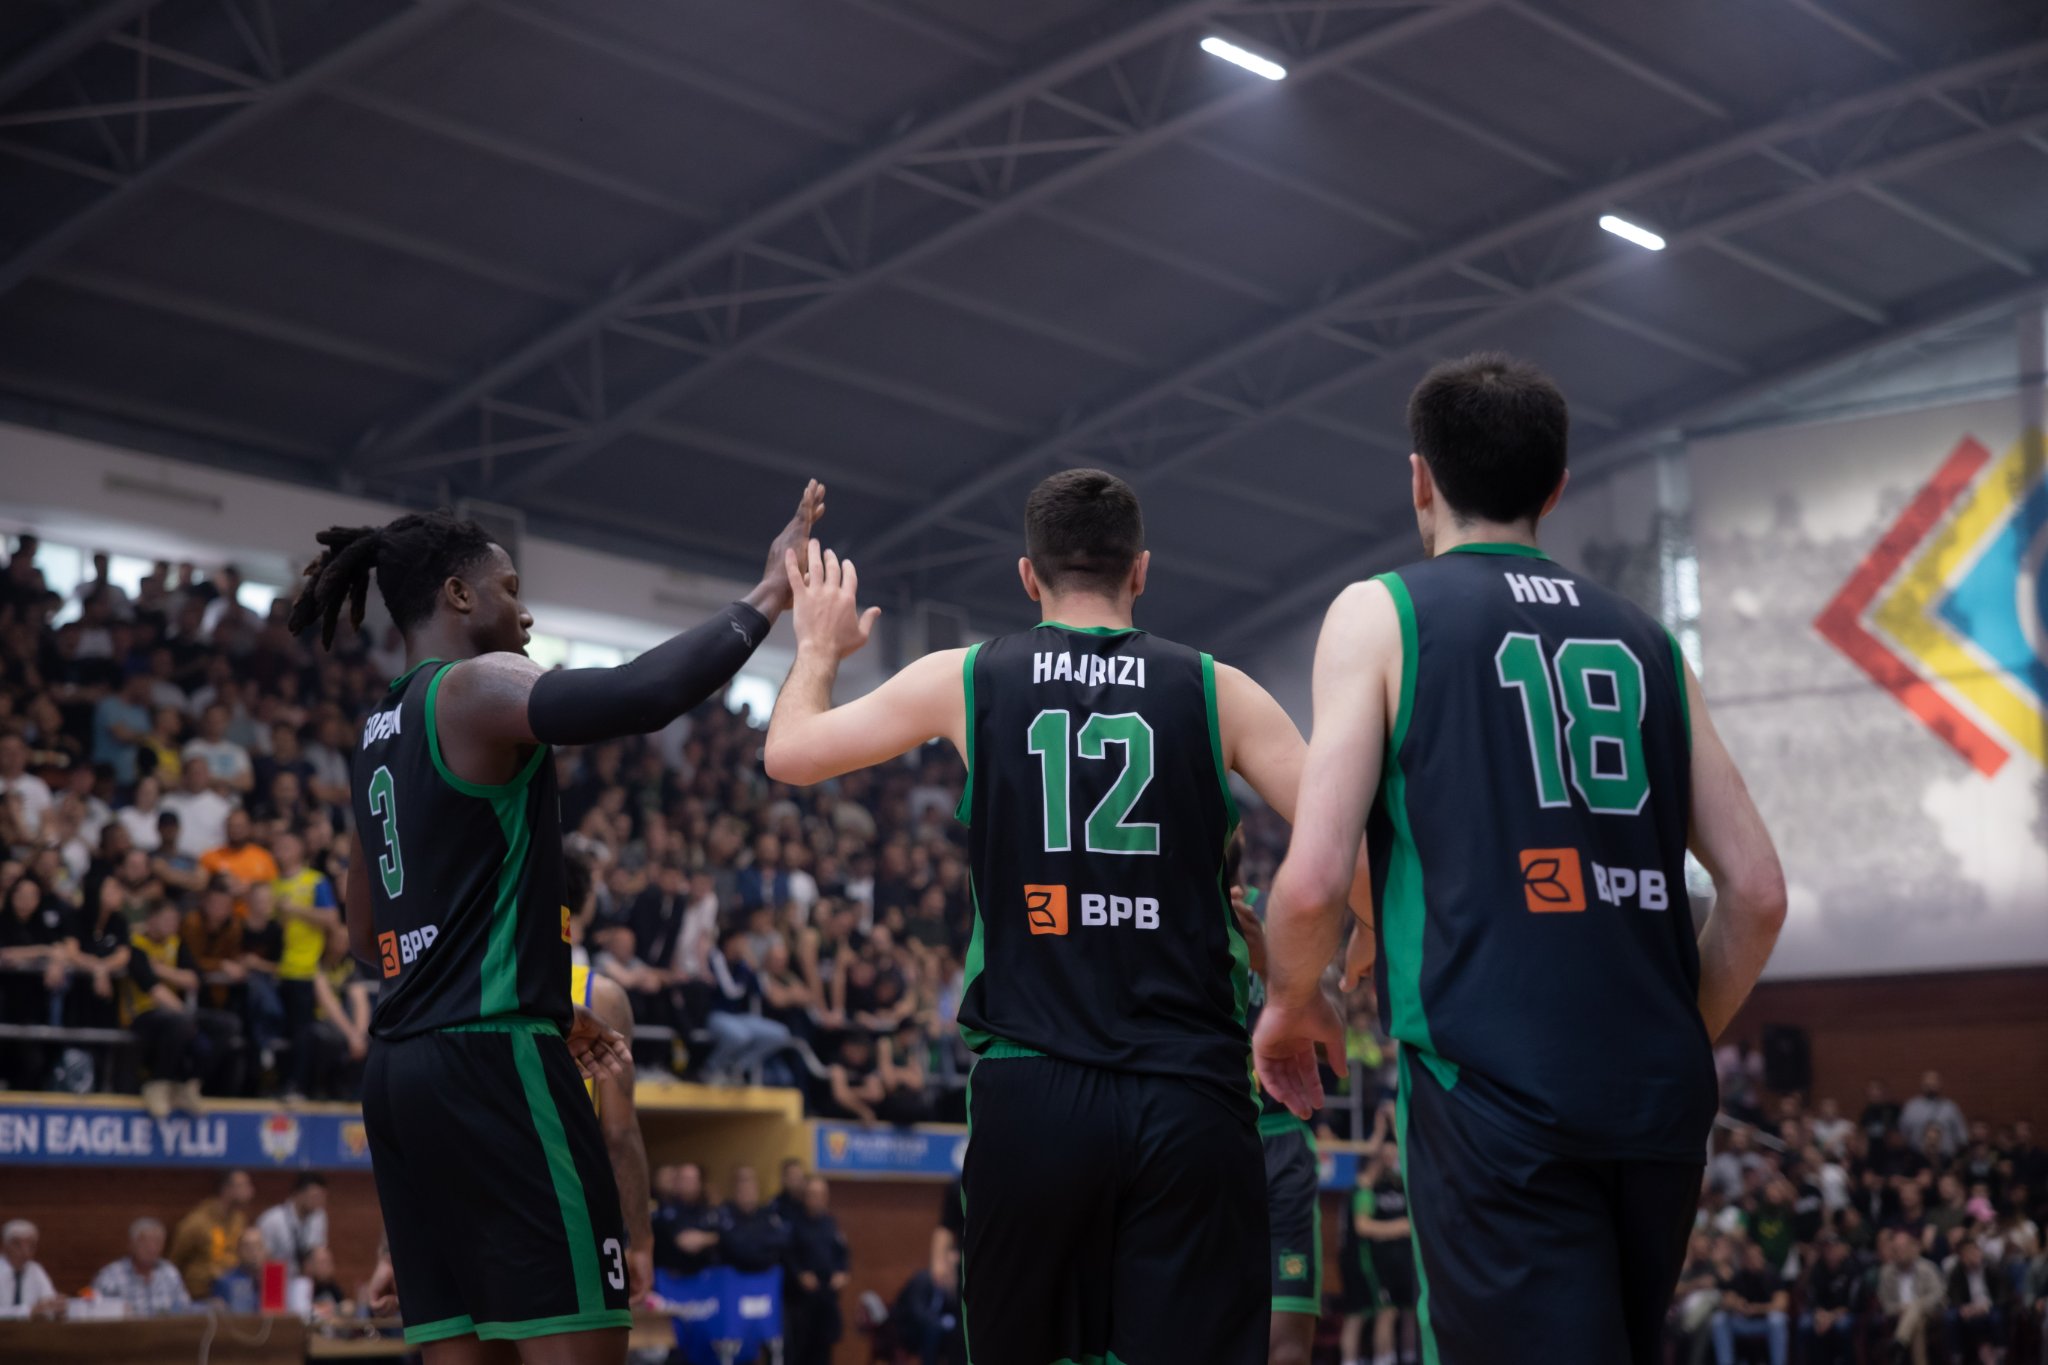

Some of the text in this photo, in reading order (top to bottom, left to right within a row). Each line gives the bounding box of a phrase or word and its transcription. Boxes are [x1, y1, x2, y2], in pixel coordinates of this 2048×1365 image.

[1504, 573, 1580, 606] HOT
[1033, 651, 1145, 688] HAJRIZI
[1495, 632, 1650, 815] 18
[1027, 709, 1160, 855] 12
[368, 765, 404, 900] 3
[1080, 893, 1160, 929] BPB
[1591, 861, 1669, 911] BPB
[46, 1114, 152, 1155] EAGLE
[603, 1238, 625, 1290] 3
